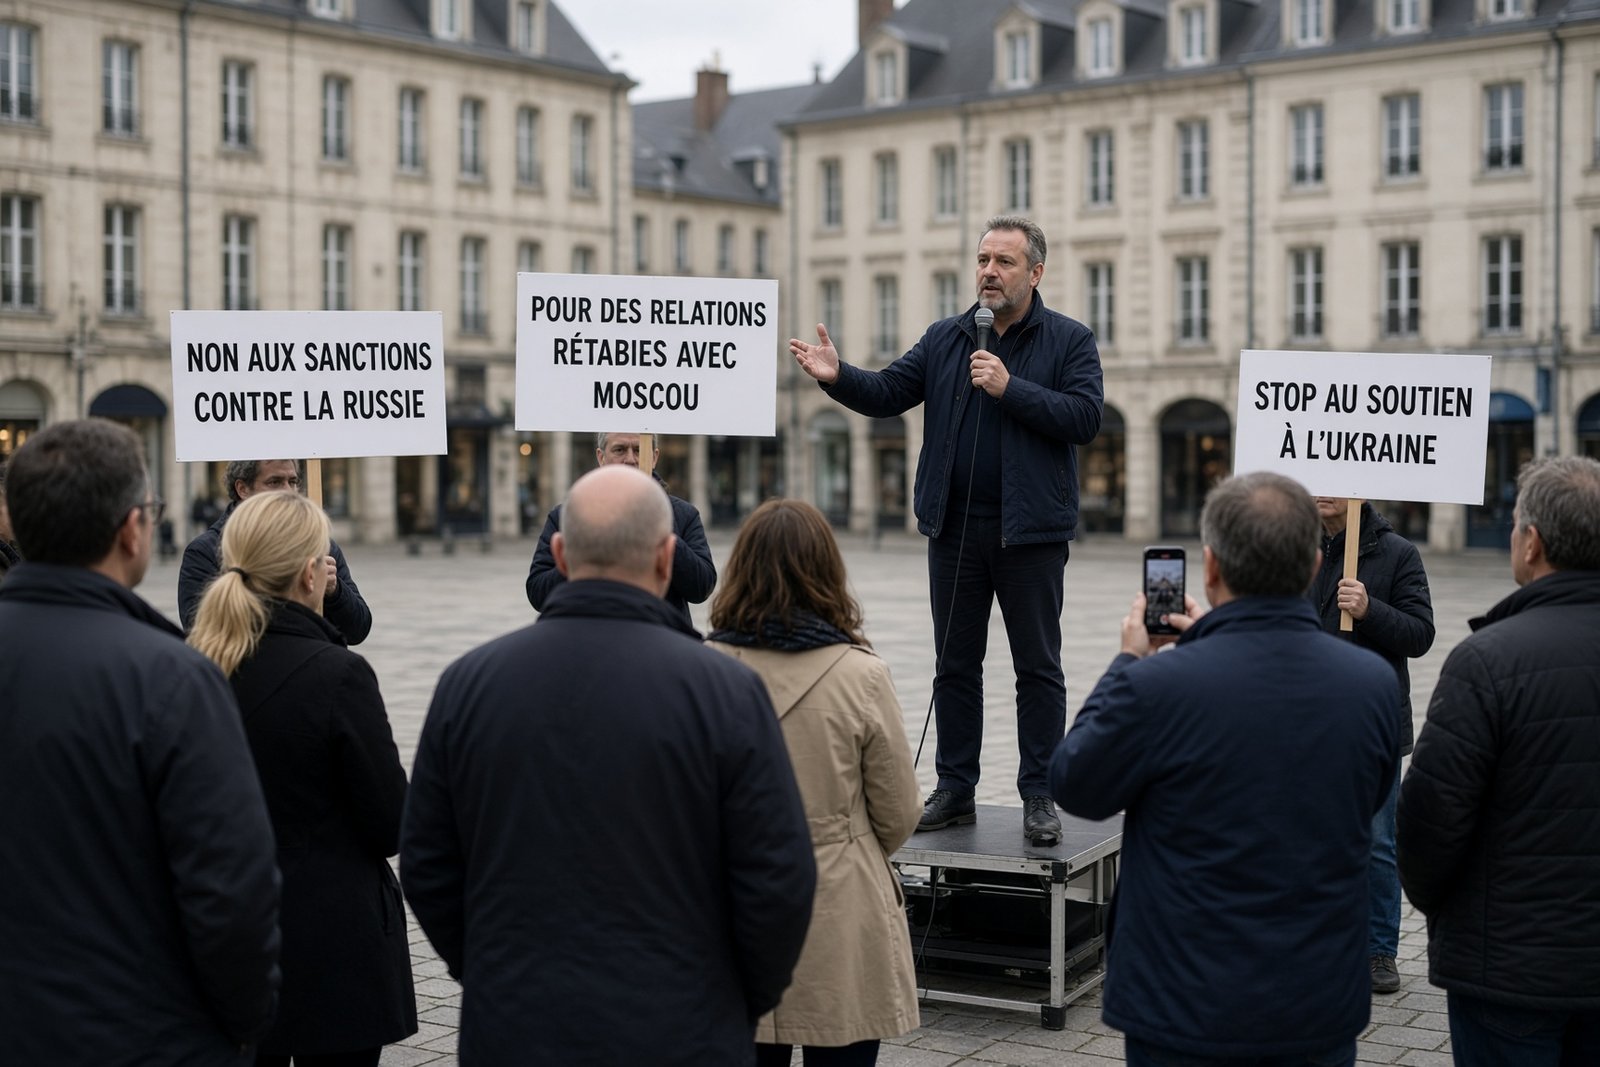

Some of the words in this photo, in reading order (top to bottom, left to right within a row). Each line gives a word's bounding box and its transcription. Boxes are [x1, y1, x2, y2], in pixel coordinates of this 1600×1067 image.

[531, 295, 592, 323] POUR
[600, 297, 642, 324] DES
[650, 299, 767, 328] RELATIONS
[187, 342, 239, 373] NON
[247, 342, 297, 373] AUX
[304, 341, 432, 372] SANCTIONS
[553, 331, 668, 368] RÉTABIES
[676, 340, 737, 370] AVEC
[194, 390, 294, 423] CONTRE
[303, 390, 335, 421] LA
[343, 389, 426, 420] RUSSIE
[593, 381, 699, 411] MOSCOU
[1254, 380, 1317, 412] STOP
[1323, 383, 1358, 414] AU
[1366, 384, 1473, 418] SOUTIEN
[1279, 421, 1297, 459] À
[1306, 430, 1438, 465] L’UKRAINE
